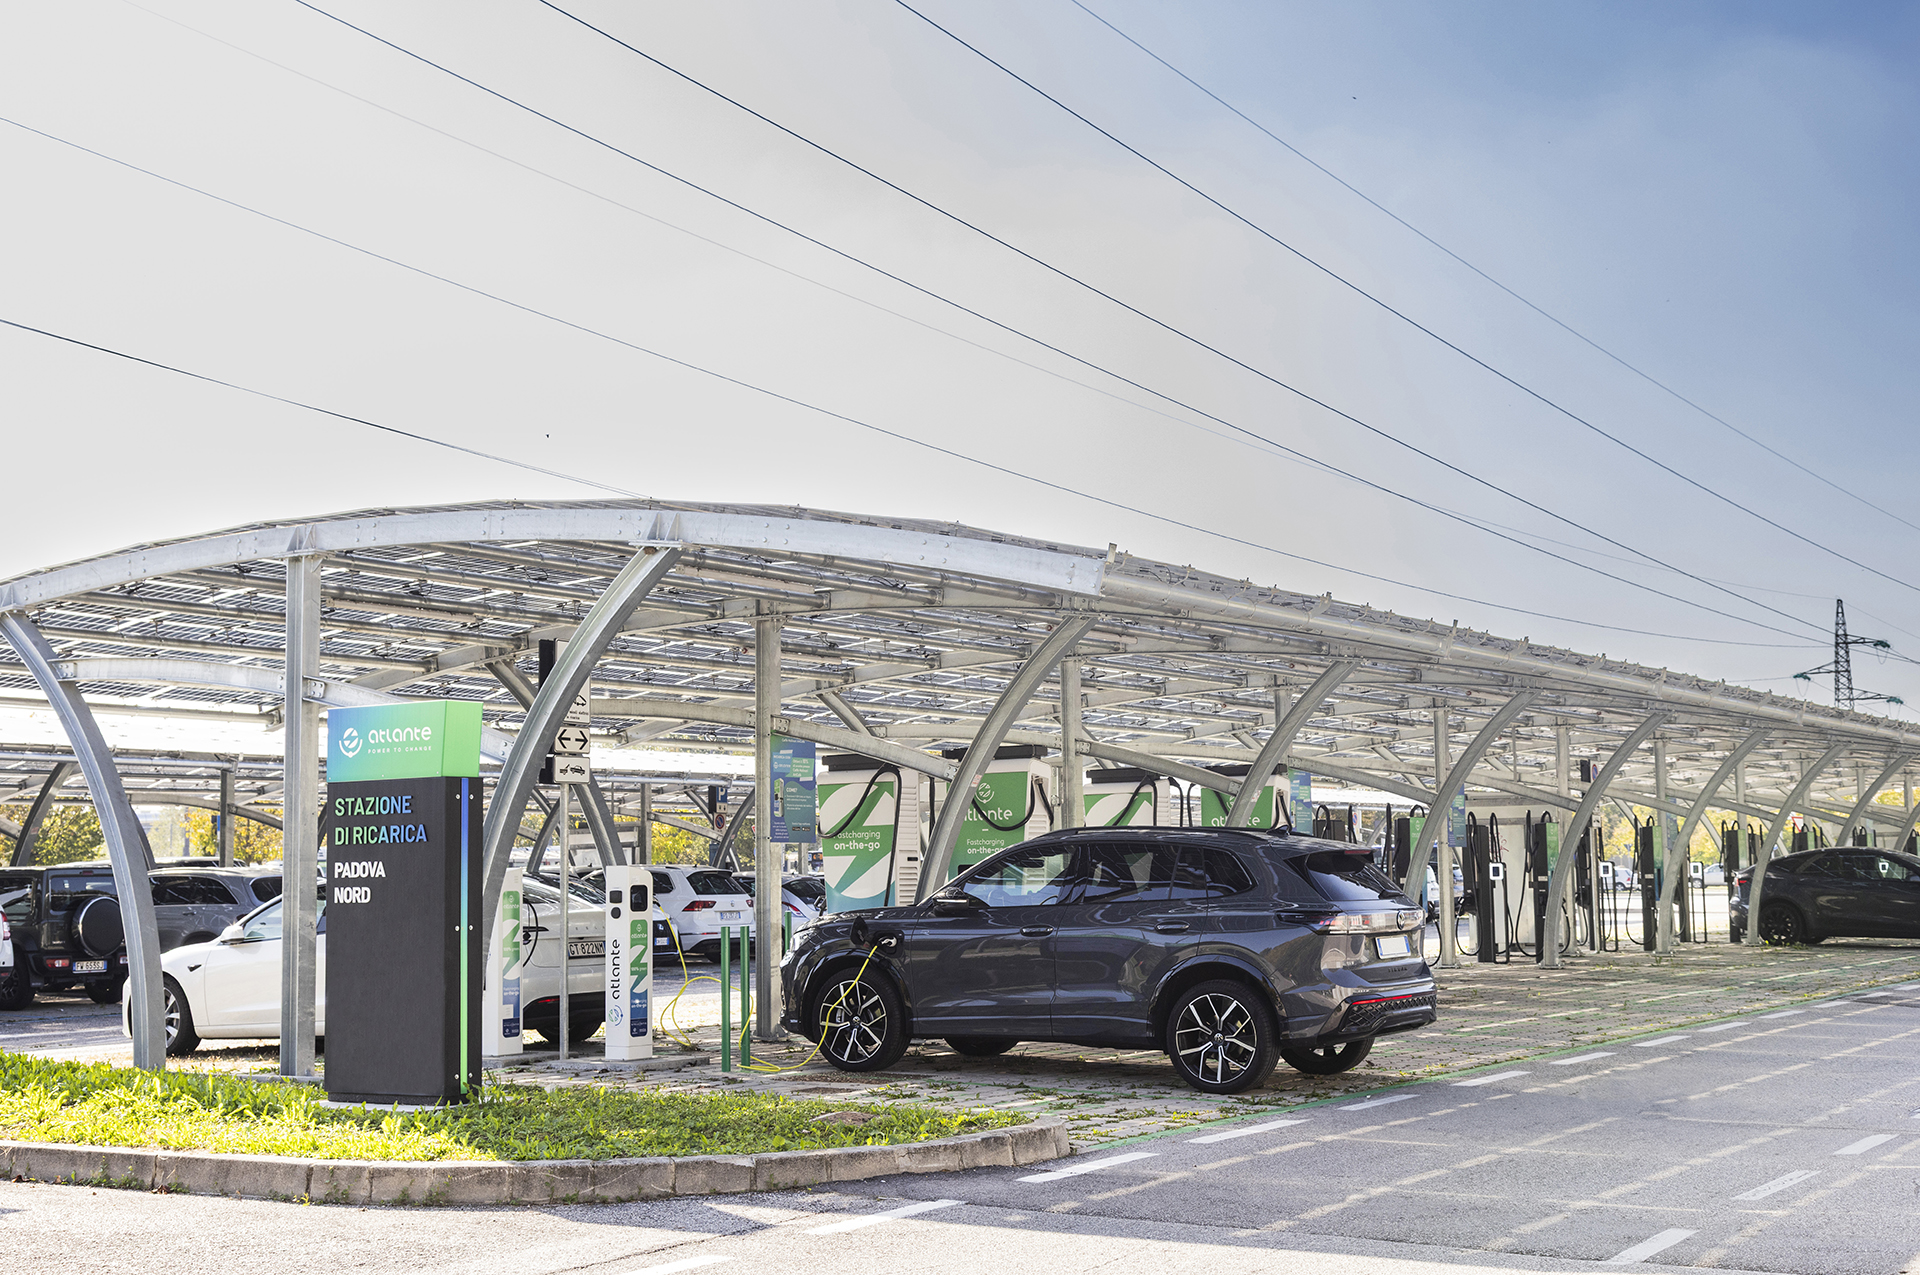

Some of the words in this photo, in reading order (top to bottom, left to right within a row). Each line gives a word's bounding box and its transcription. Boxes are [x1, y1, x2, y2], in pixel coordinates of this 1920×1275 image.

[368, 726, 432, 744] atlante
[335, 796, 412, 816] STAZIONE
[335, 827, 349, 845] DI
[353, 824, 427, 845] RICARICA
[833, 830, 881, 840] astcharging
[966, 838, 1005, 846] Fastcharging
[833, 840, 881, 852] on-the-go
[334, 861, 386, 879] PADOVA
[334, 886, 371, 904] NORD
[569, 943, 579, 956] GT
[580, 942, 605, 954] 822NM
[610, 938, 621, 1000] atlante
